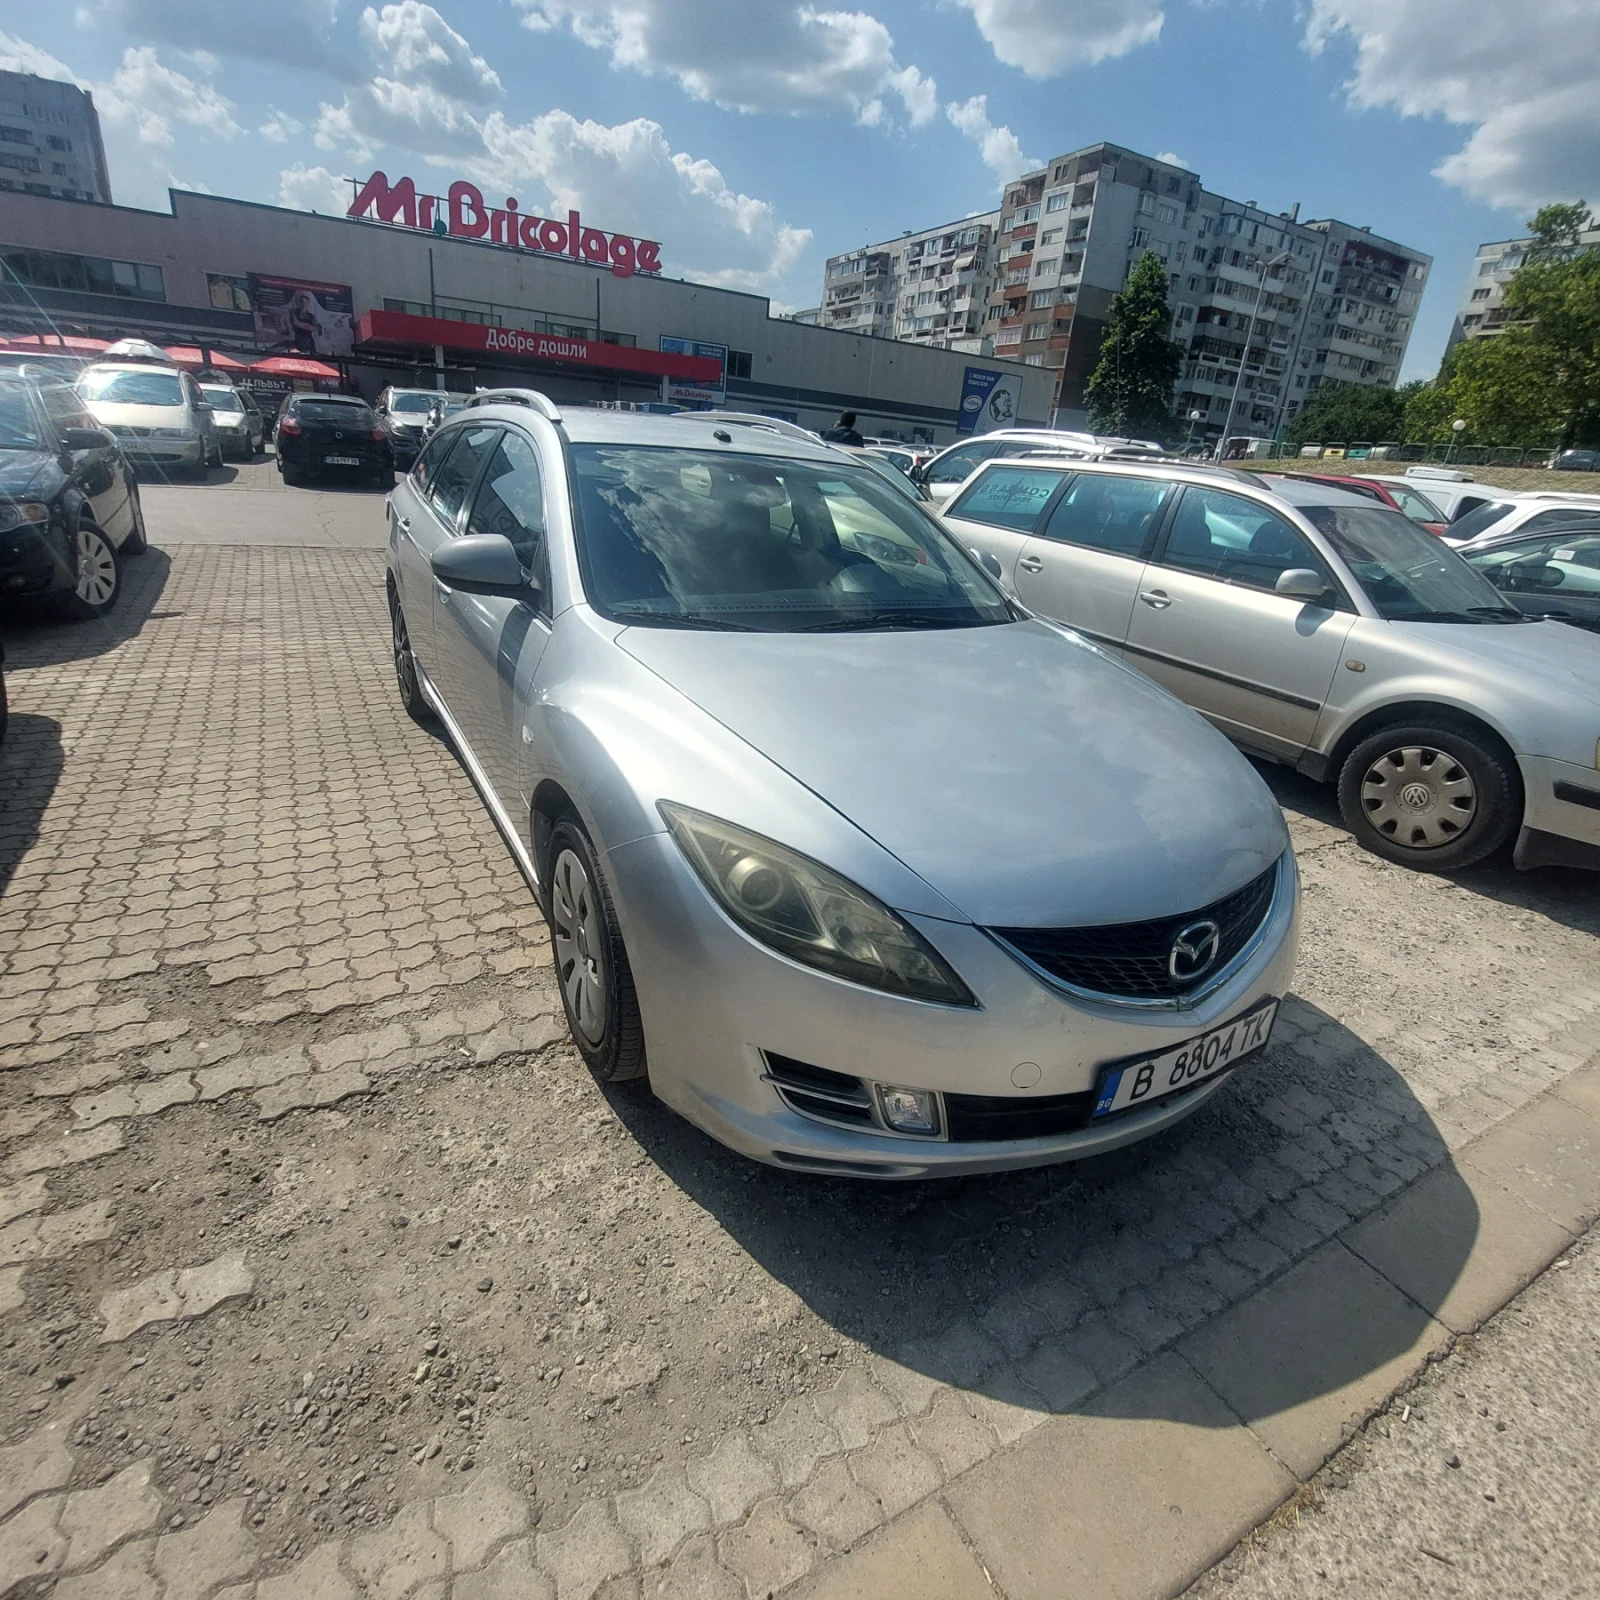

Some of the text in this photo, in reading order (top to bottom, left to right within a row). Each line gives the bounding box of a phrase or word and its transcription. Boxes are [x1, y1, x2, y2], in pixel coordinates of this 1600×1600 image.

[486, 328, 587, 359] Добре дошли
[1129, 1008, 1271, 1101] B 8804 TK
[1096, 1097, 1112, 1111] BG
